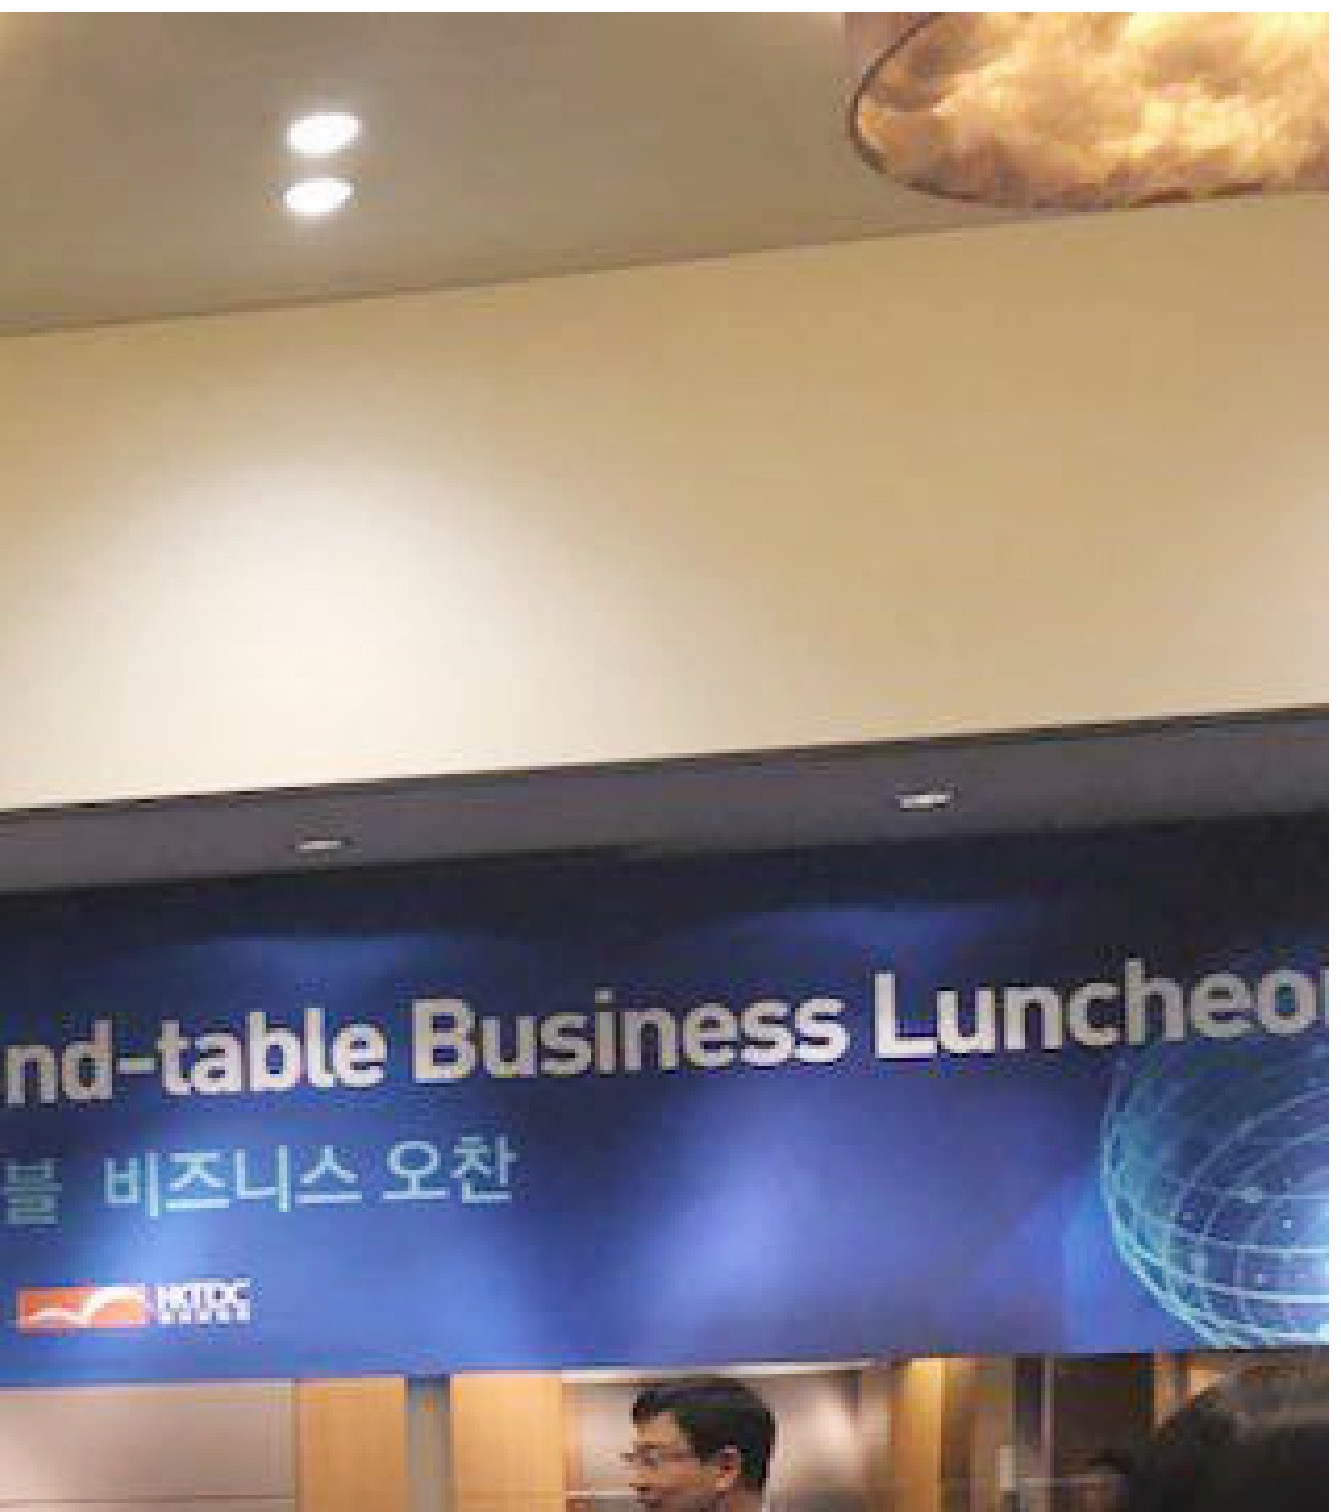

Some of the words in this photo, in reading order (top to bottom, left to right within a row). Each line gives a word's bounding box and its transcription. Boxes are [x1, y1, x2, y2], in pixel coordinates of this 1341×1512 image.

[411, 989, 851, 1083] Business
[873, 958, 1329, 1061] Luncheo
[104, 1142, 361, 1217] 비즈니스
[382, 1131, 517, 1203] 오찬
